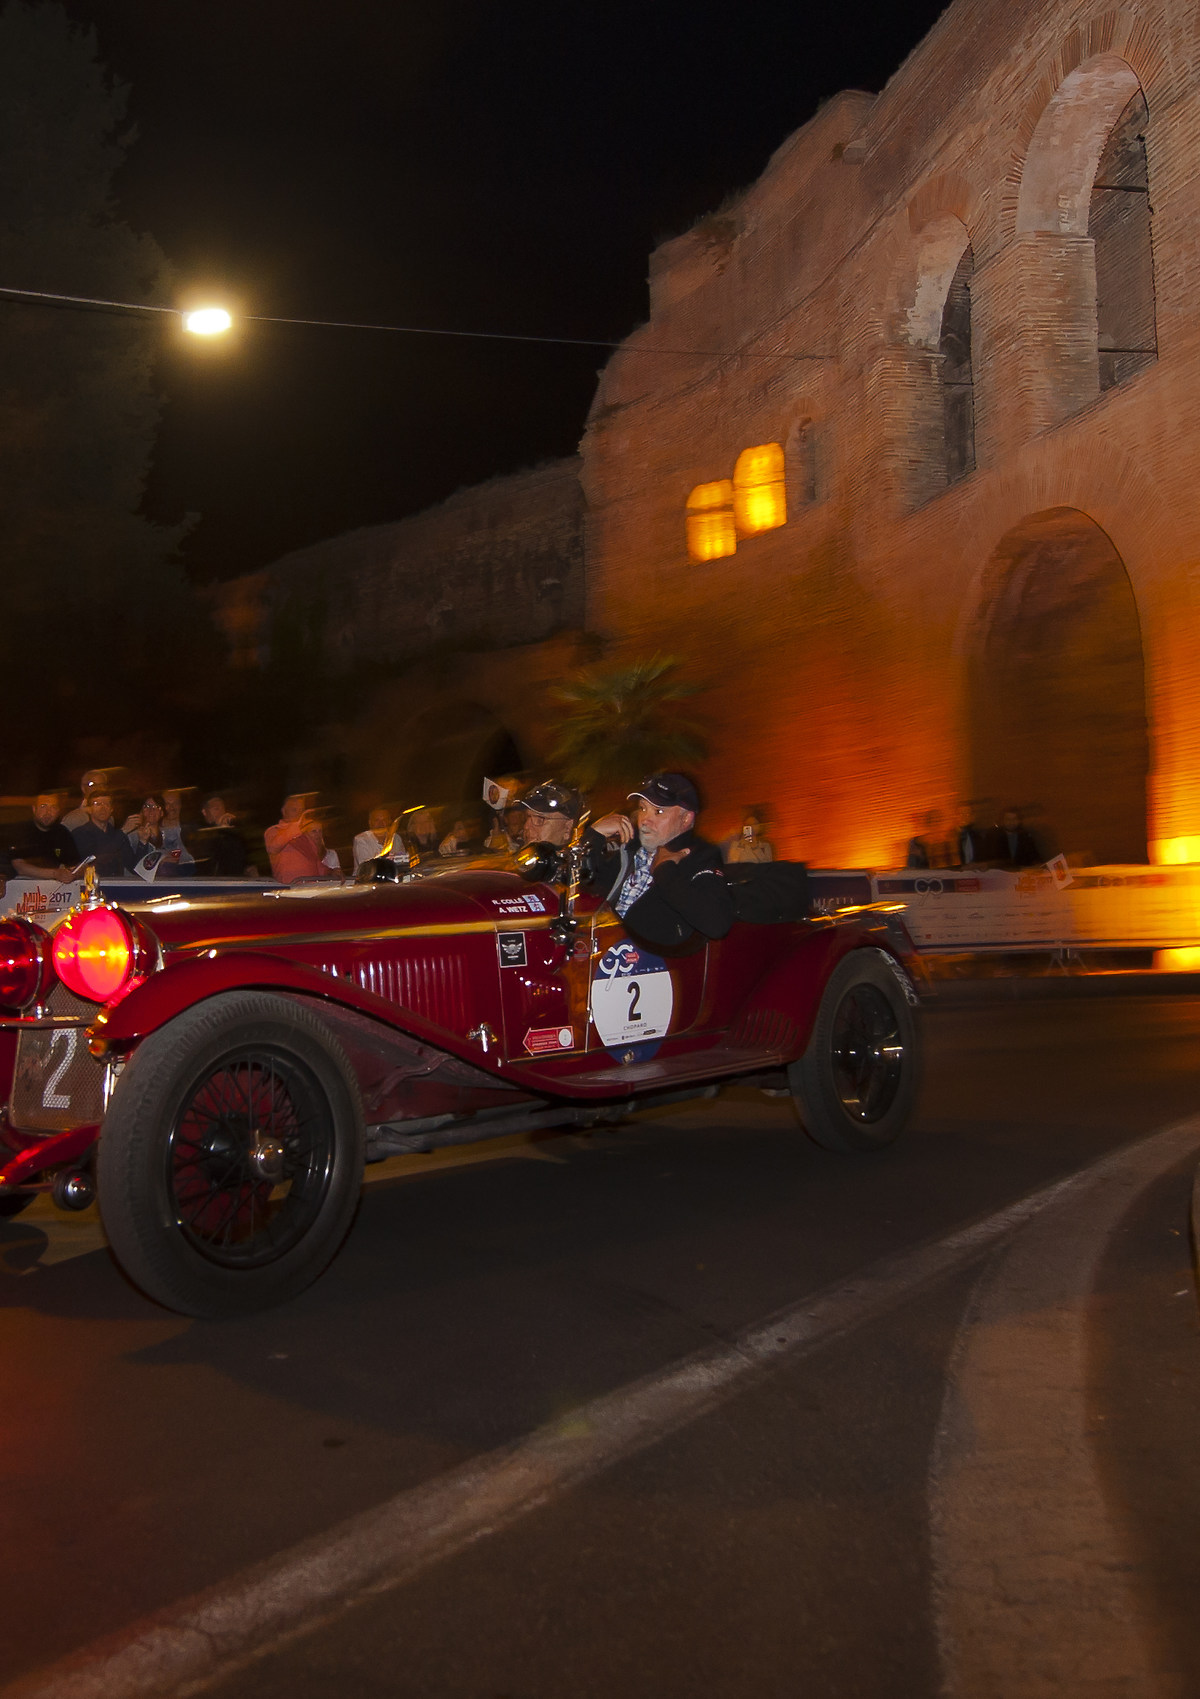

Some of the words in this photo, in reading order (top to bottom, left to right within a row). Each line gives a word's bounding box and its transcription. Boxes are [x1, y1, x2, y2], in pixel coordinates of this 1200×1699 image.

[23, 885, 48, 903] Mille
[49, 892, 72, 903] 2017
[627, 981, 642, 1022] 2
[42, 1027, 78, 1109] 2
